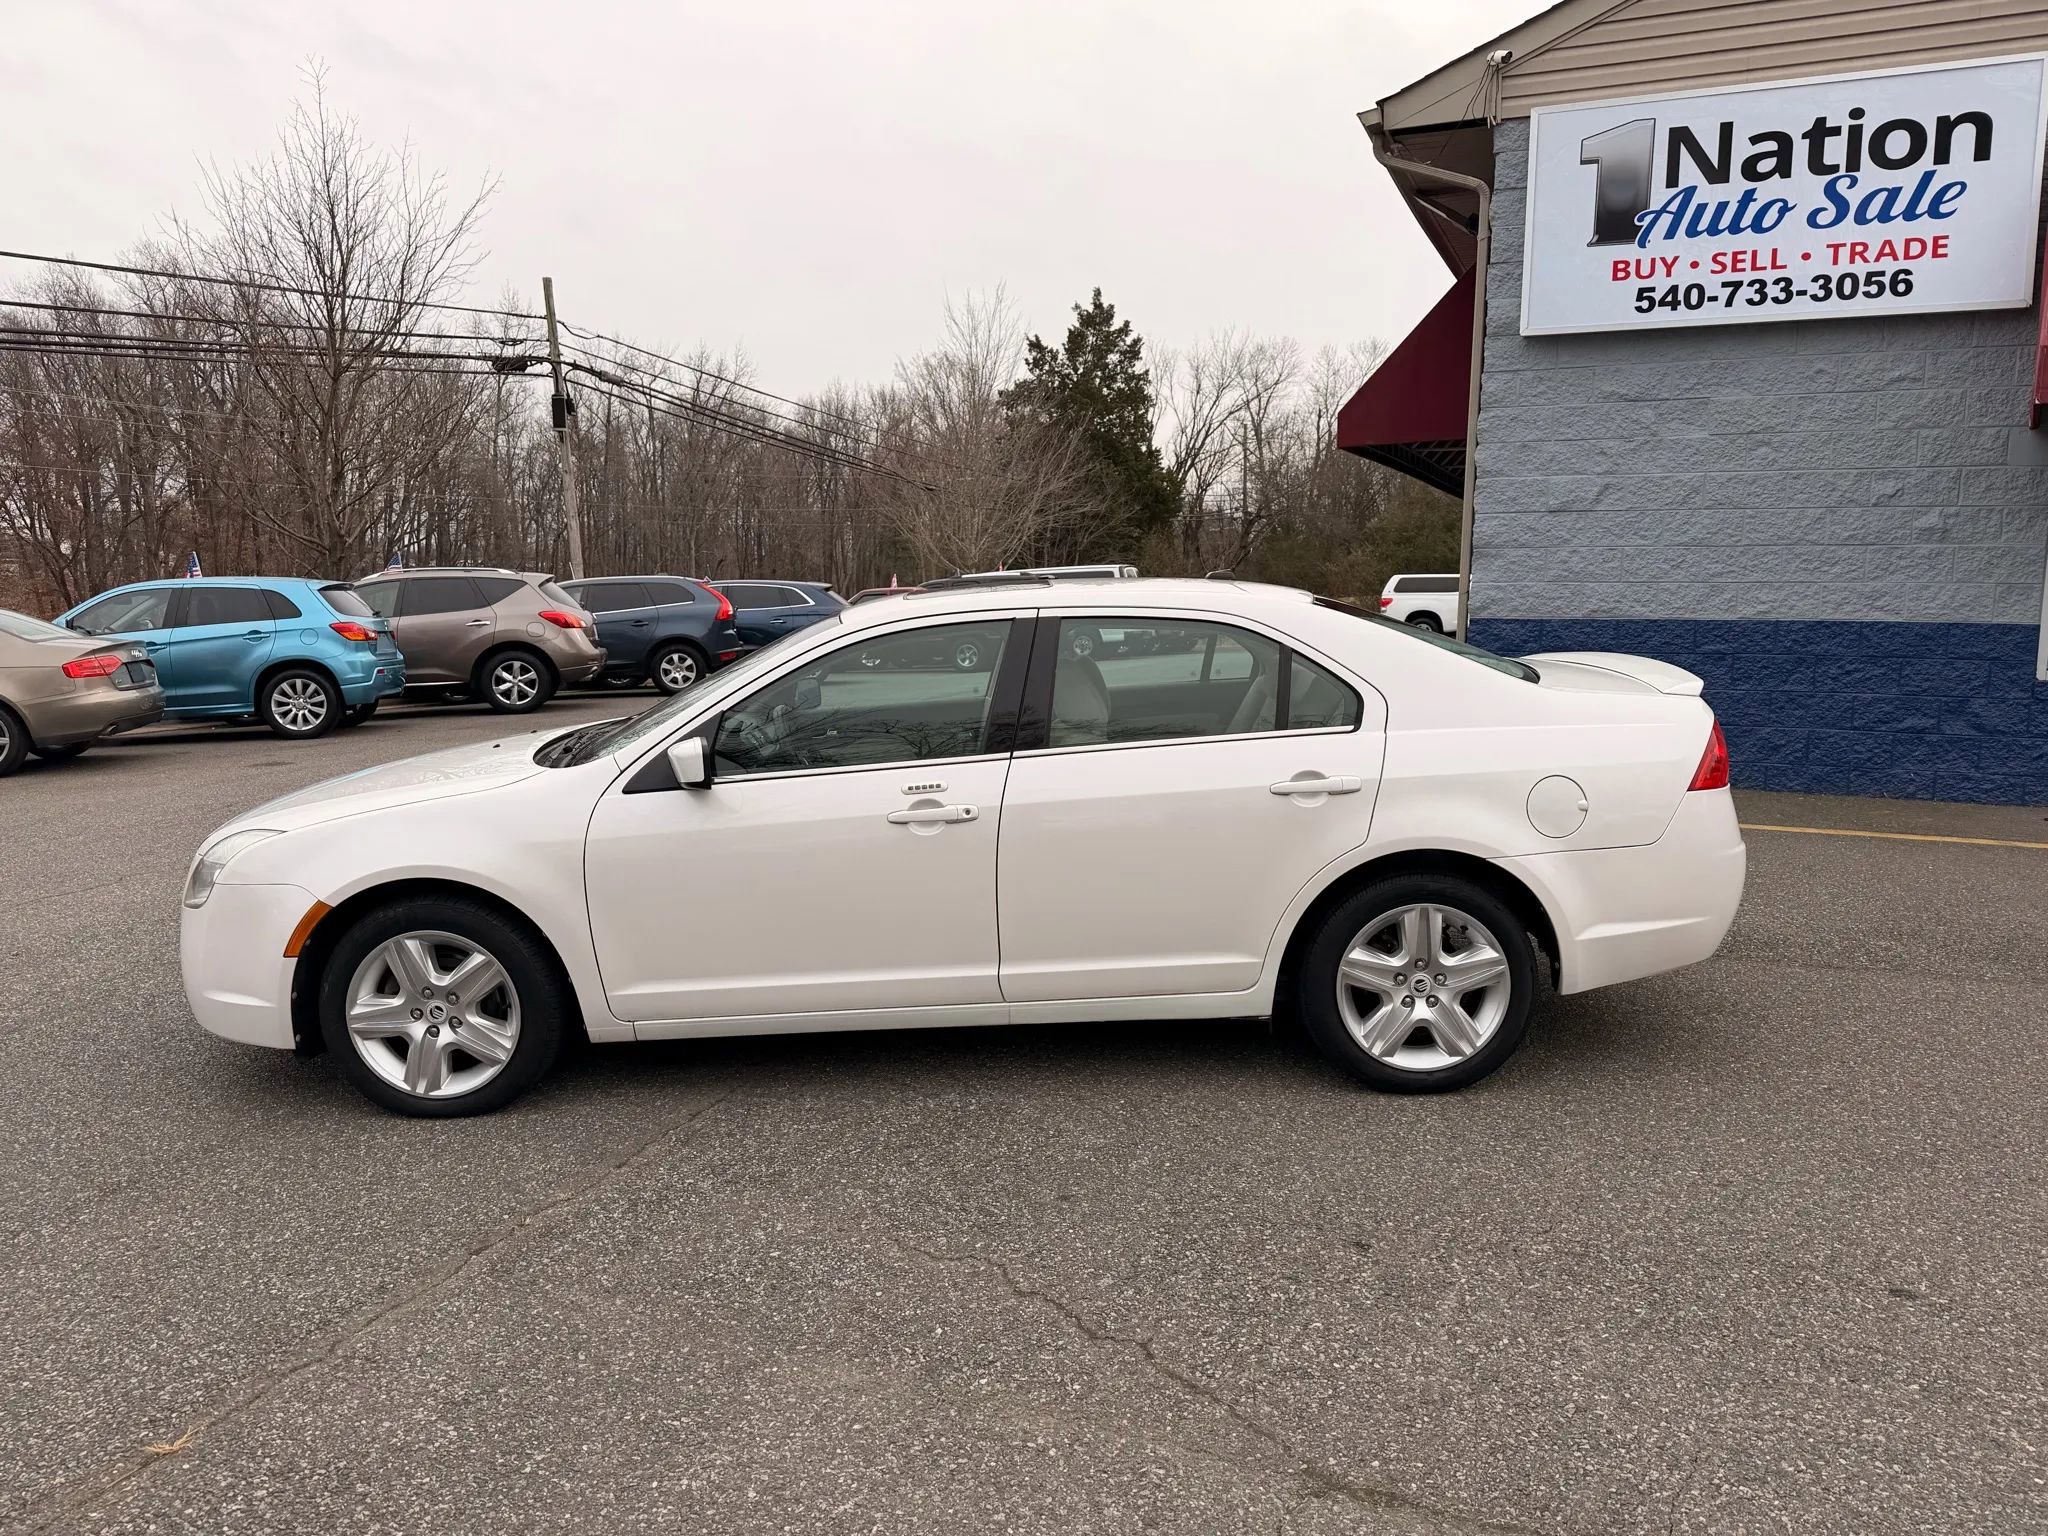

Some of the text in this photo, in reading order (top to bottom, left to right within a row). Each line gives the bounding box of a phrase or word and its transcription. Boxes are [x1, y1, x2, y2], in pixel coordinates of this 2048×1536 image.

[1580, 107, 1993, 248] 1 Nation
[1634, 169, 1968, 249] Auto Sale
[1611, 234, 1950, 282] BUY SELL TRADE
[1634, 268, 1914, 314] 540-733-3056
